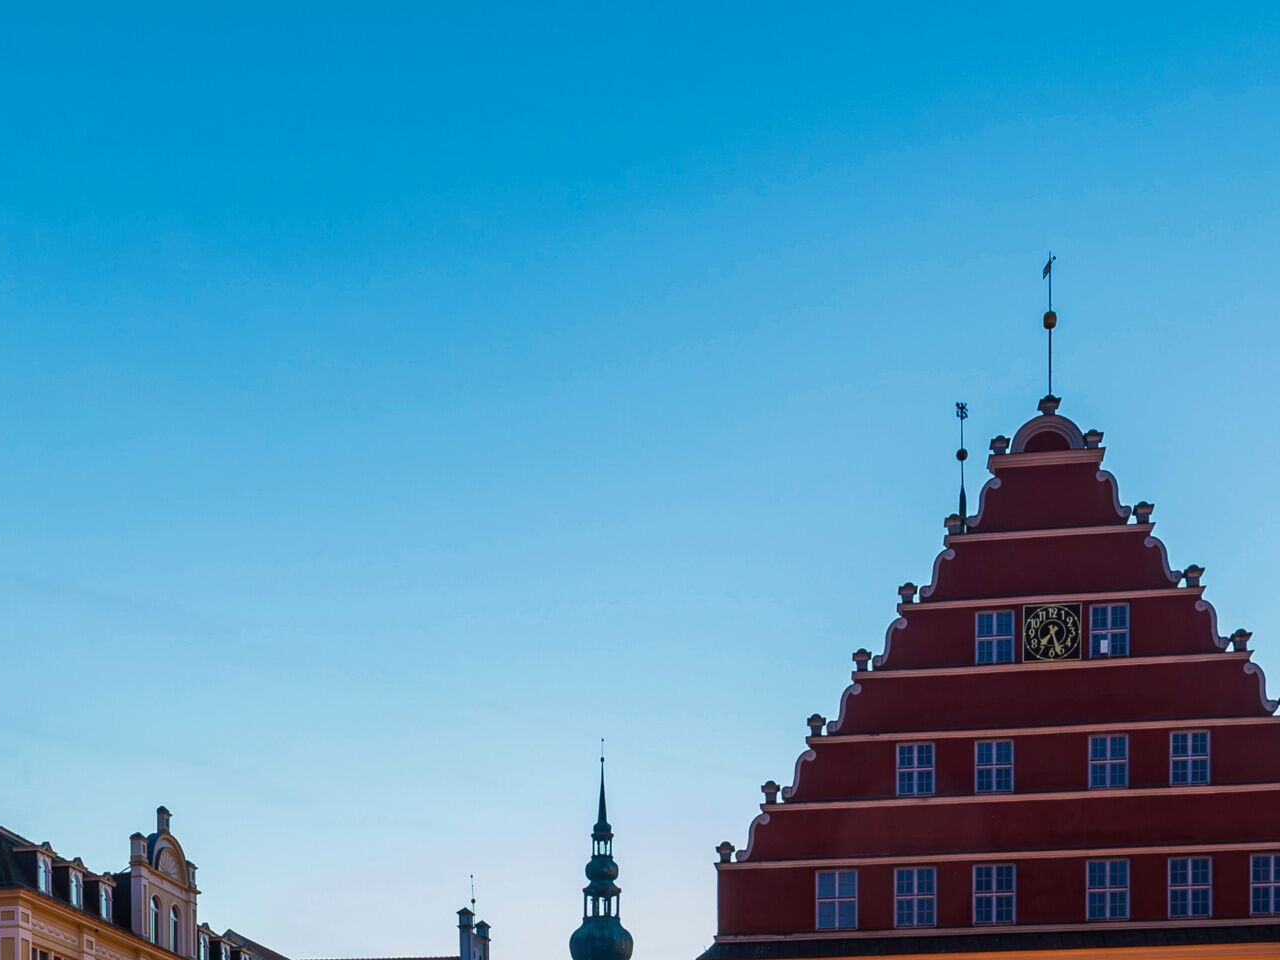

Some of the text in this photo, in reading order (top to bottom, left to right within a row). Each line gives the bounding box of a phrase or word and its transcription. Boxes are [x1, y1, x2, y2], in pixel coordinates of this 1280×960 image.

[1038, 611, 1046, 621] 11
[1048, 607, 1058, 618] 12
[1060, 610, 1065, 620] 1
[1030, 618, 1040, 628] 10
[1066, 616, 1073, 627] 2
[1028, 628, 1036, 639] 9
[1069, 627, 1076, 637] 3
[1031, 638, 1038, 649] 8
[1066, 637, 1071, 648] 4
[1038, 645, 1045, 656] 7
[1049, 647, 1055, 657] 6
